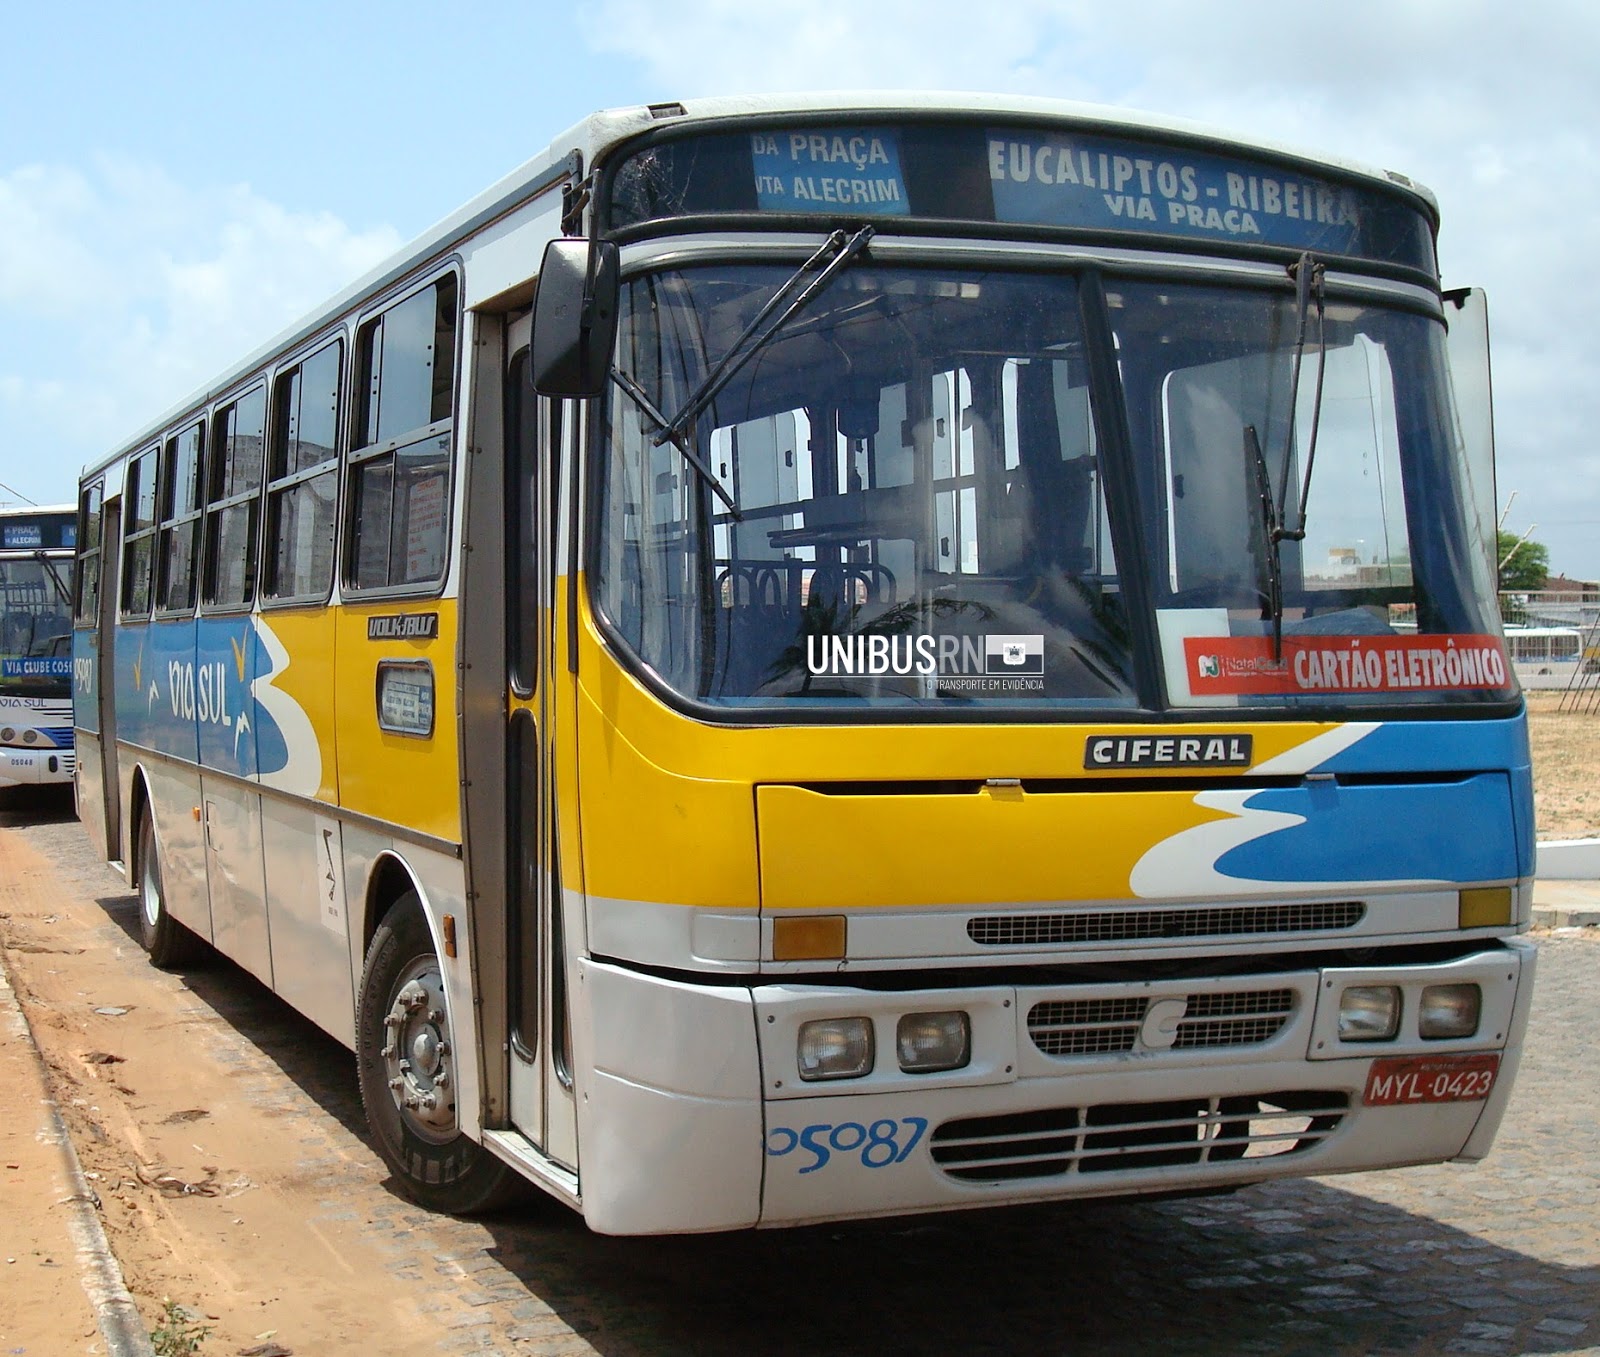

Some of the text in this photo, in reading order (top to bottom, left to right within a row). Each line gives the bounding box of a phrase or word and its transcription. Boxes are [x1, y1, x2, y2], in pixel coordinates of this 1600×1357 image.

[790, 134, 889, 171] PRAÇA
[988, 140, 1198, 202] EUCALIPTOS
[794, 176, 900, 204] ALECRIM
[1103, 193, 1260, 235] VIA PRAÇA
[6, 661, 22, 674] VIA
[23, 661, 50, 674] CLUBE
[1294, 638, 1506, 689] CARTÃO ELETRÔNICO
[24, 698, 47, 708] SUL
[198, 661, 231, 727] SUL
[1093, 738, 1246, 763] CIFERAL
[761, 1116, 929, 1174] 05087
